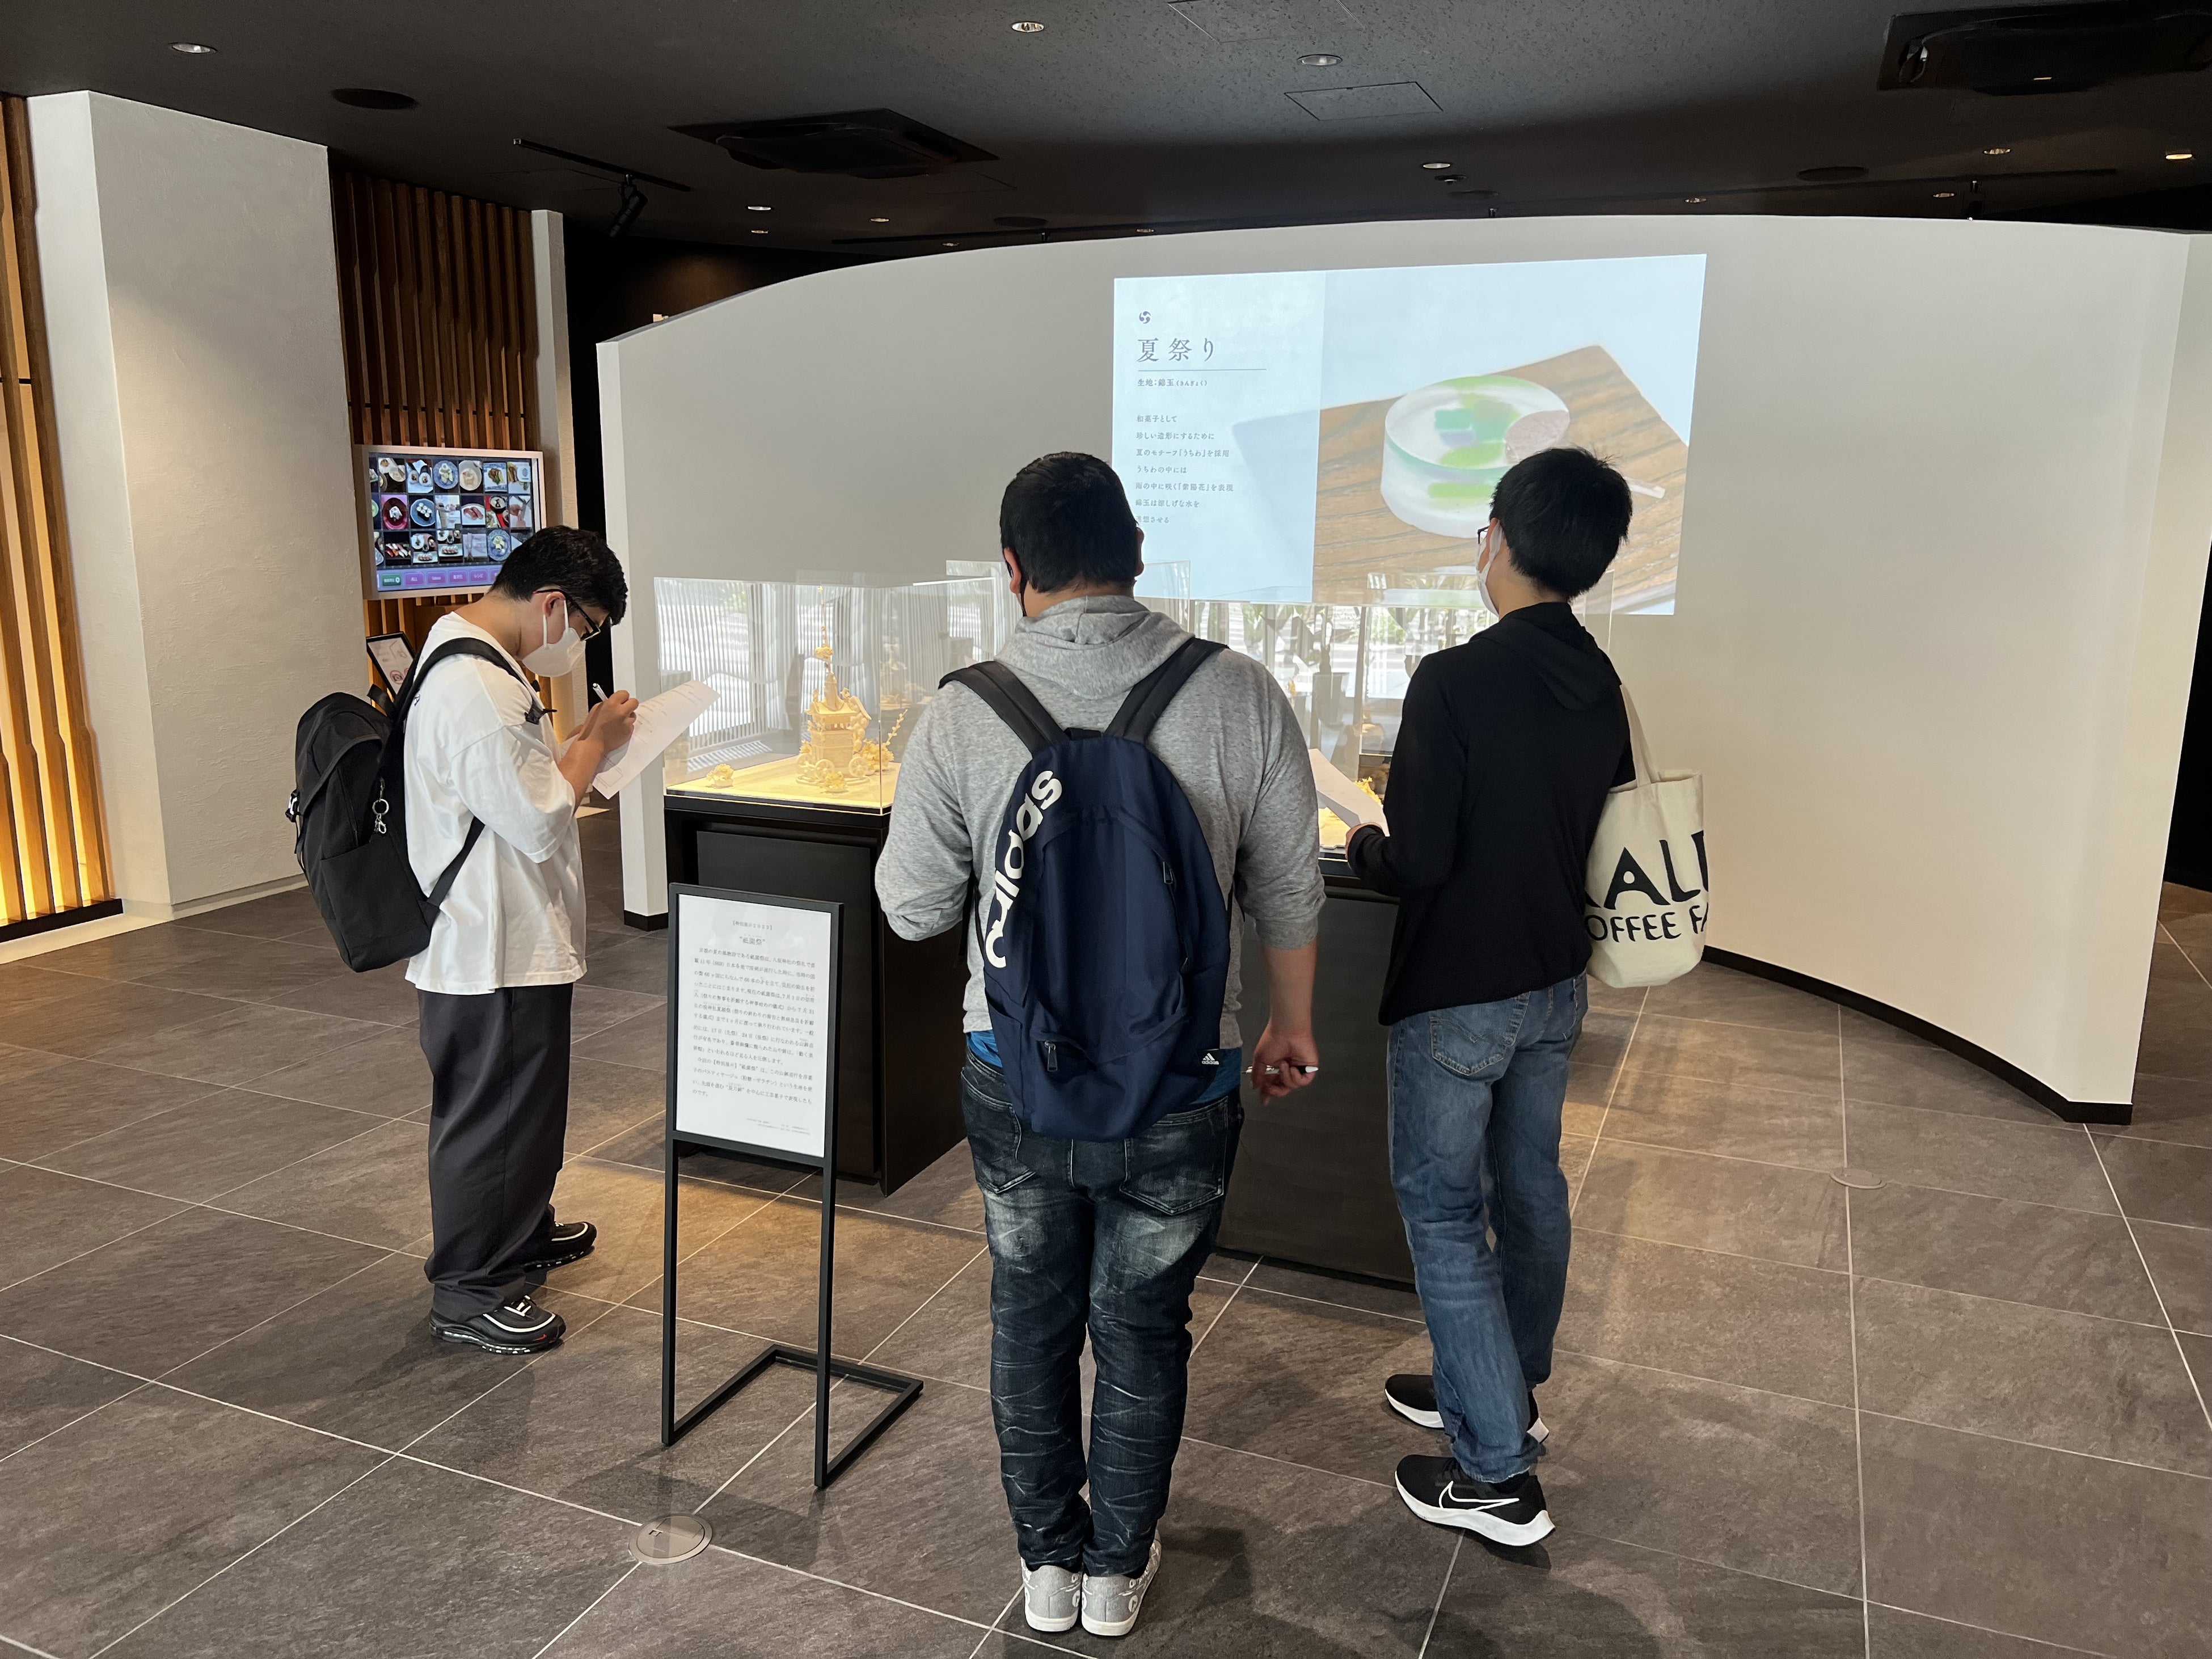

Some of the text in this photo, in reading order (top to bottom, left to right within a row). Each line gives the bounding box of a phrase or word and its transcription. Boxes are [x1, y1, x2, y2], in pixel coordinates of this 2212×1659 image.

[1137, 337, 1215, 362] 夏祭り
[1135, 449, 1230, 457] 夏のモチーフ「うちわ」を採用
[1137, 465, 1187, 474] うちわの中には
[1135, 482, 1234, 492] 雨の中に咲く「紫陽花」を表現
[1135, 499, 1200, 508] 錦玉は涼しげな水を
[1585, 830, 1709, 910] AL
